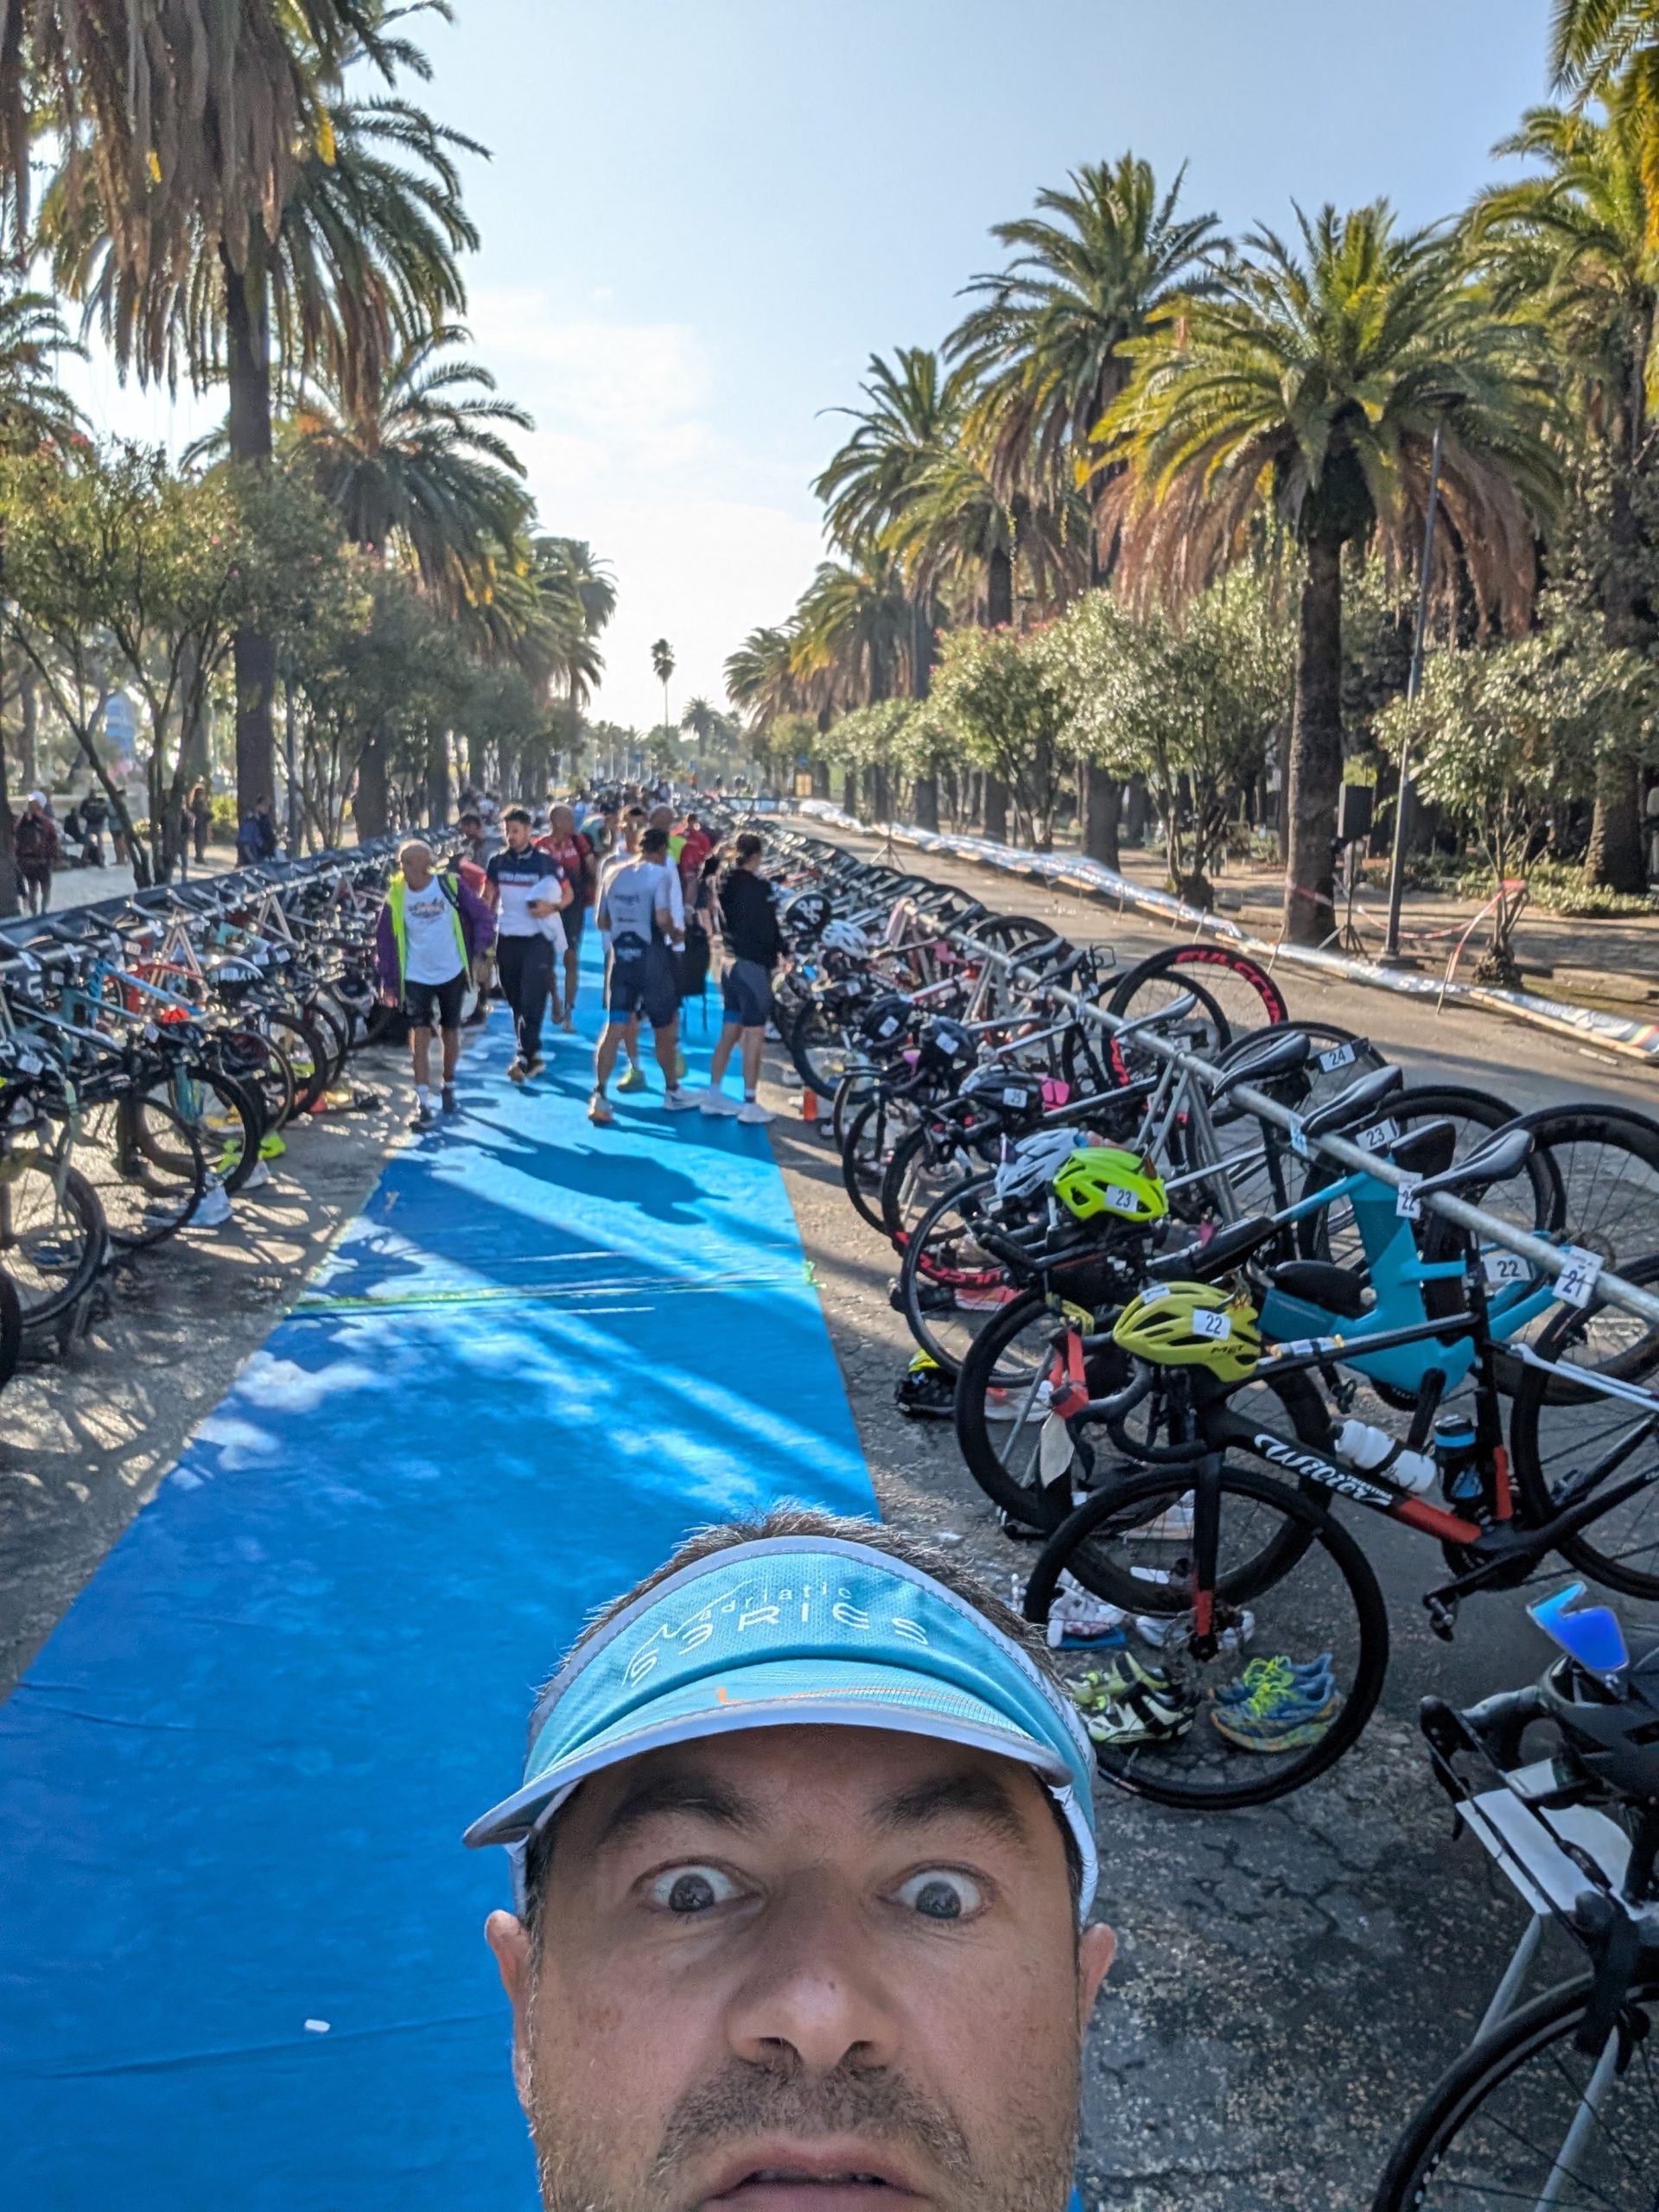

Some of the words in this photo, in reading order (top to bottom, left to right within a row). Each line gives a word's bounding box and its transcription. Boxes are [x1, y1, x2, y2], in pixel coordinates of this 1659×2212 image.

[1328, 1049, 1346, 1066] 24
[1366, 1127, 1385, 1147] 23
[1116, 1189, 1131, 1208] 23
[1497, 1260, 1522, 1278] 22
[1561, 1269, 1583, 1298] 21
[1205, 1314, 1223, 1335] 22
[1211, 1344, 1244, 1355] MET
[698, 1581, 852, 1621] adriatic
